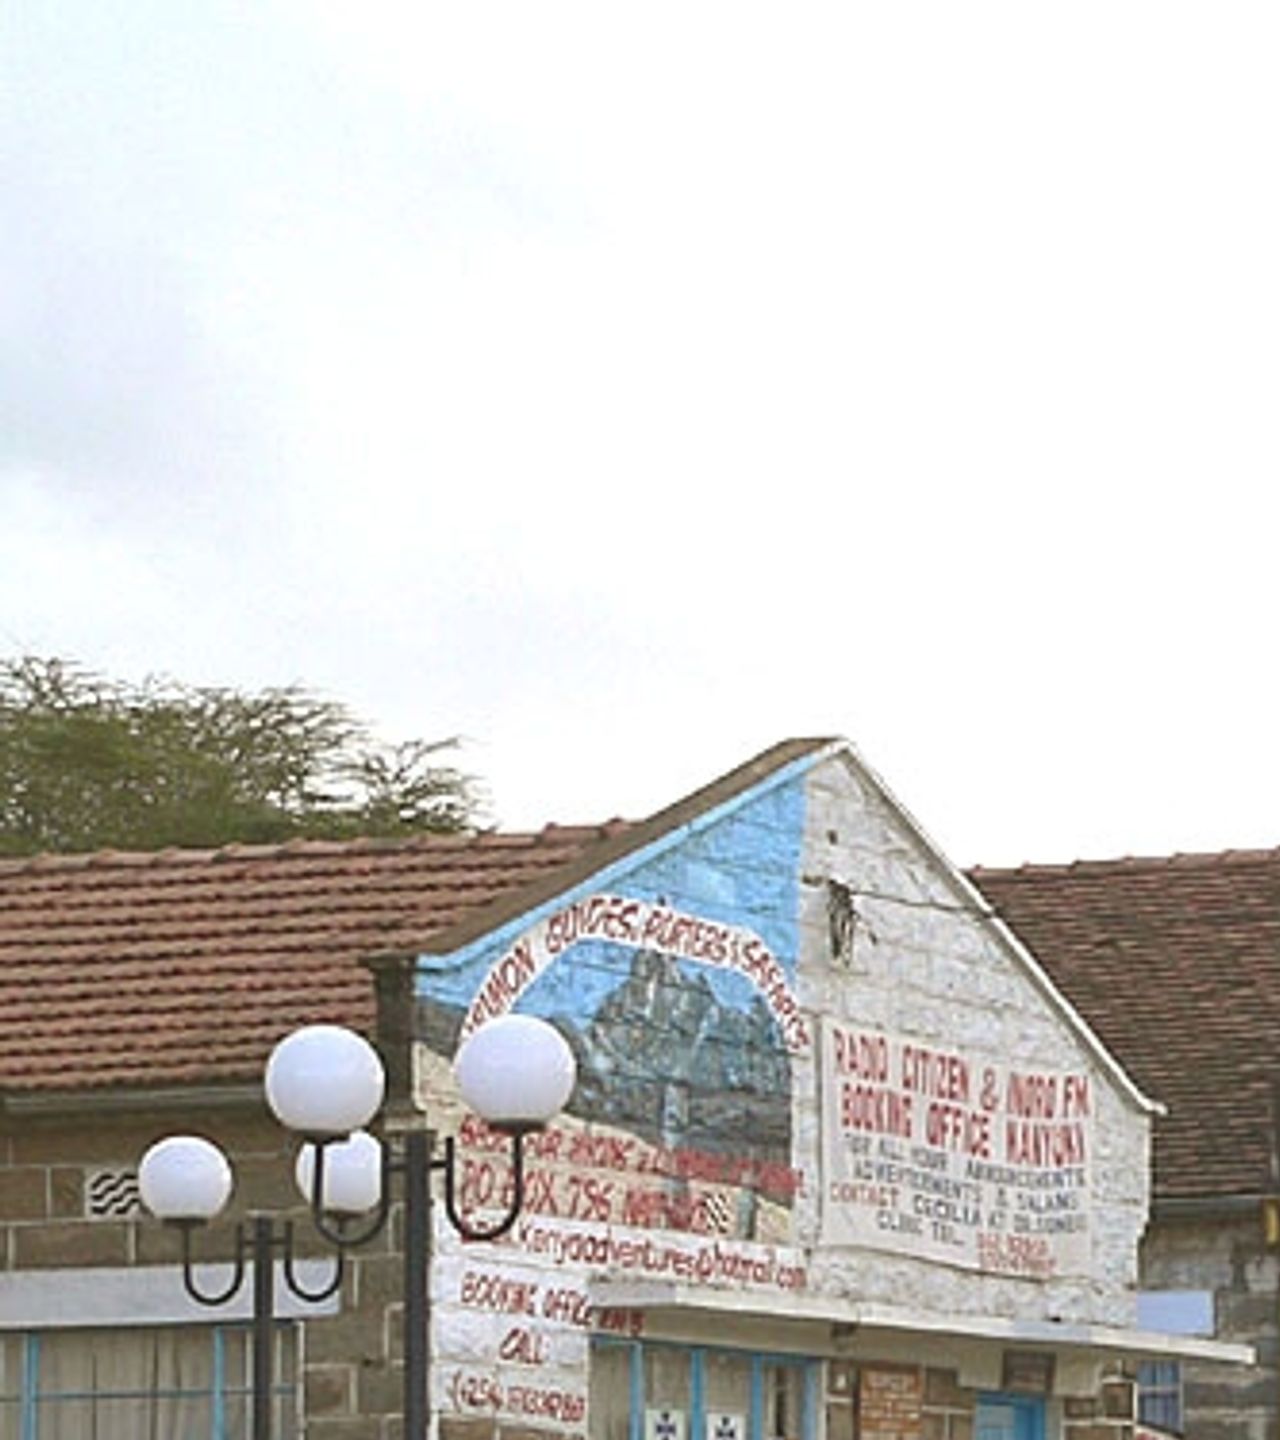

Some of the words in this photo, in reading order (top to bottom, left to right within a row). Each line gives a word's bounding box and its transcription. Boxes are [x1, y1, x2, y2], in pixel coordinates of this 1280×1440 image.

[833, 1028, 887, 1083] RADIO
[902, 1045, 969, 1102] CITIZEN
[980, 1068, 998, 1112] &
[1064, 1075, 1090, 1119] FM
[840, 1082, 911, 1138] BOOKING
[926, 1101, 991, 1159] OFFICE
[830, 1182, 899, 1207] CONTACT
[461, 1271, 538, 1318] BOOKING
[499, 1327, 546, 1366] CALL
